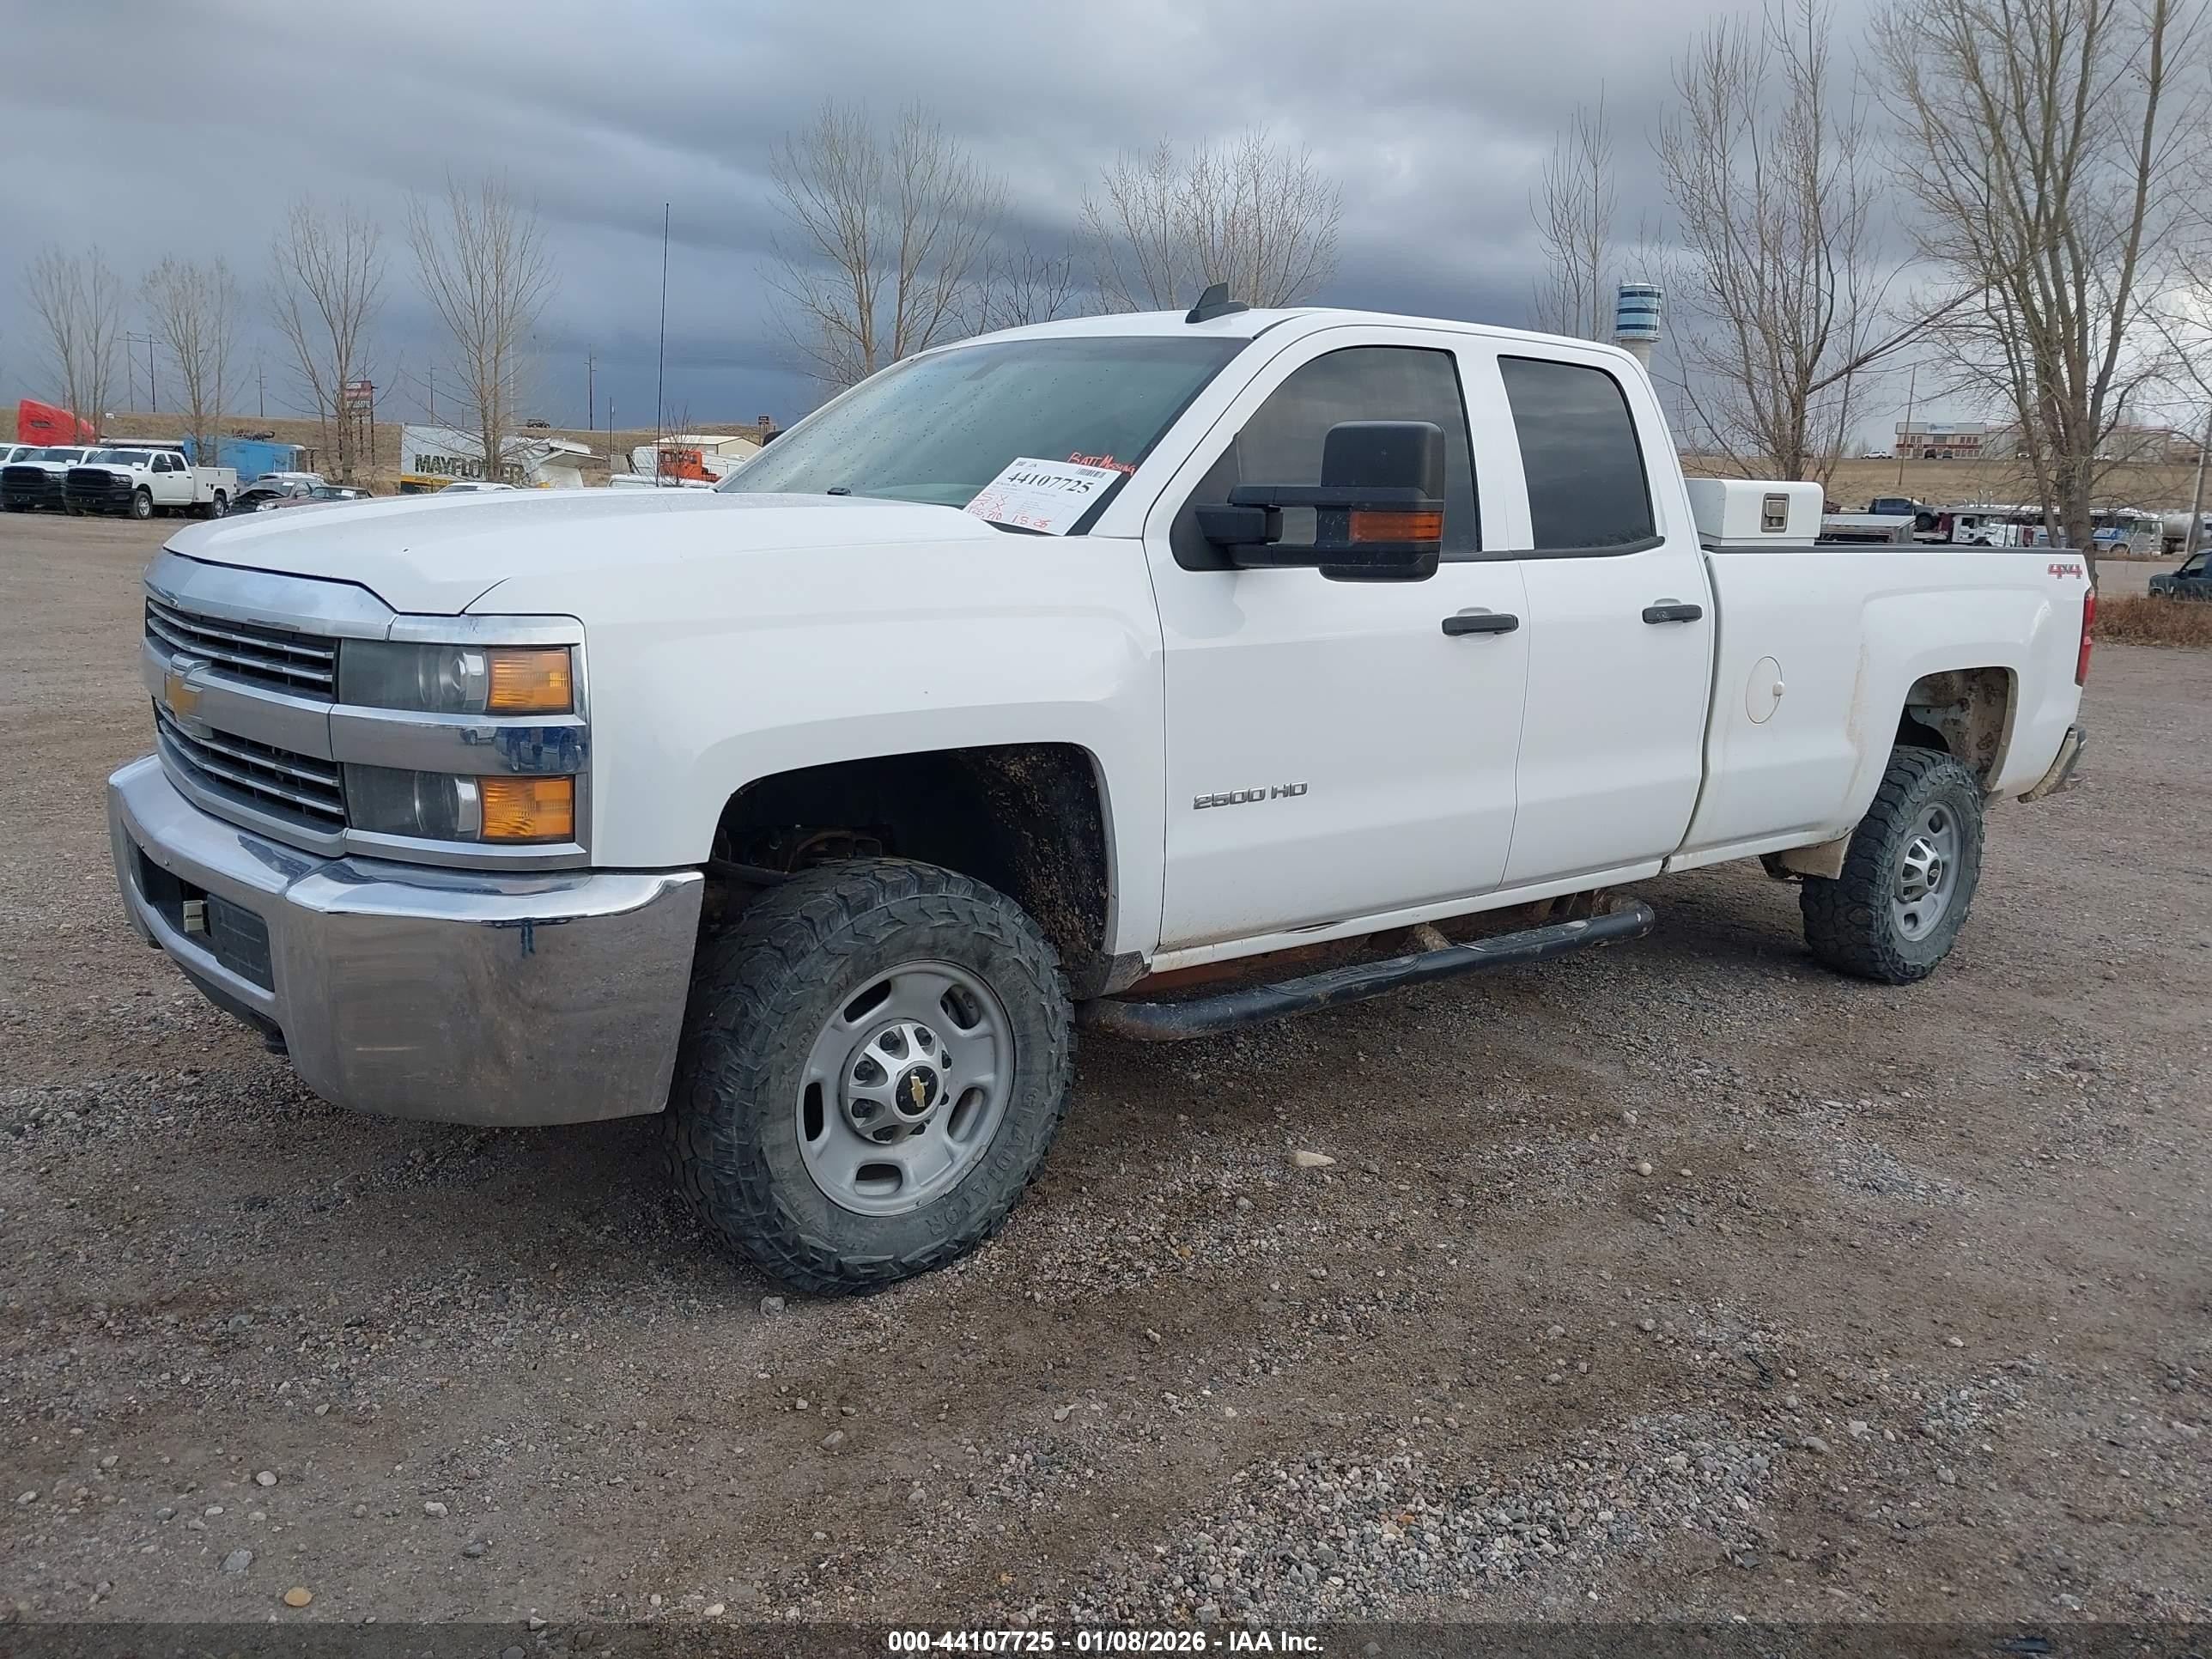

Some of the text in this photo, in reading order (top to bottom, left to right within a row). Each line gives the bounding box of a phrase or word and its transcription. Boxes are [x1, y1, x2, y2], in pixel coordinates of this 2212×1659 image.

[415, 453, 525, 483] MAYFLOER
[1067, 451, 1103, 466] BATT
[1007, 471, 1095, 494] 44107725
[1193, 781, 1309, 810] 2500 HD
[927, 1087, 1039, 1237] GLADIATOR
